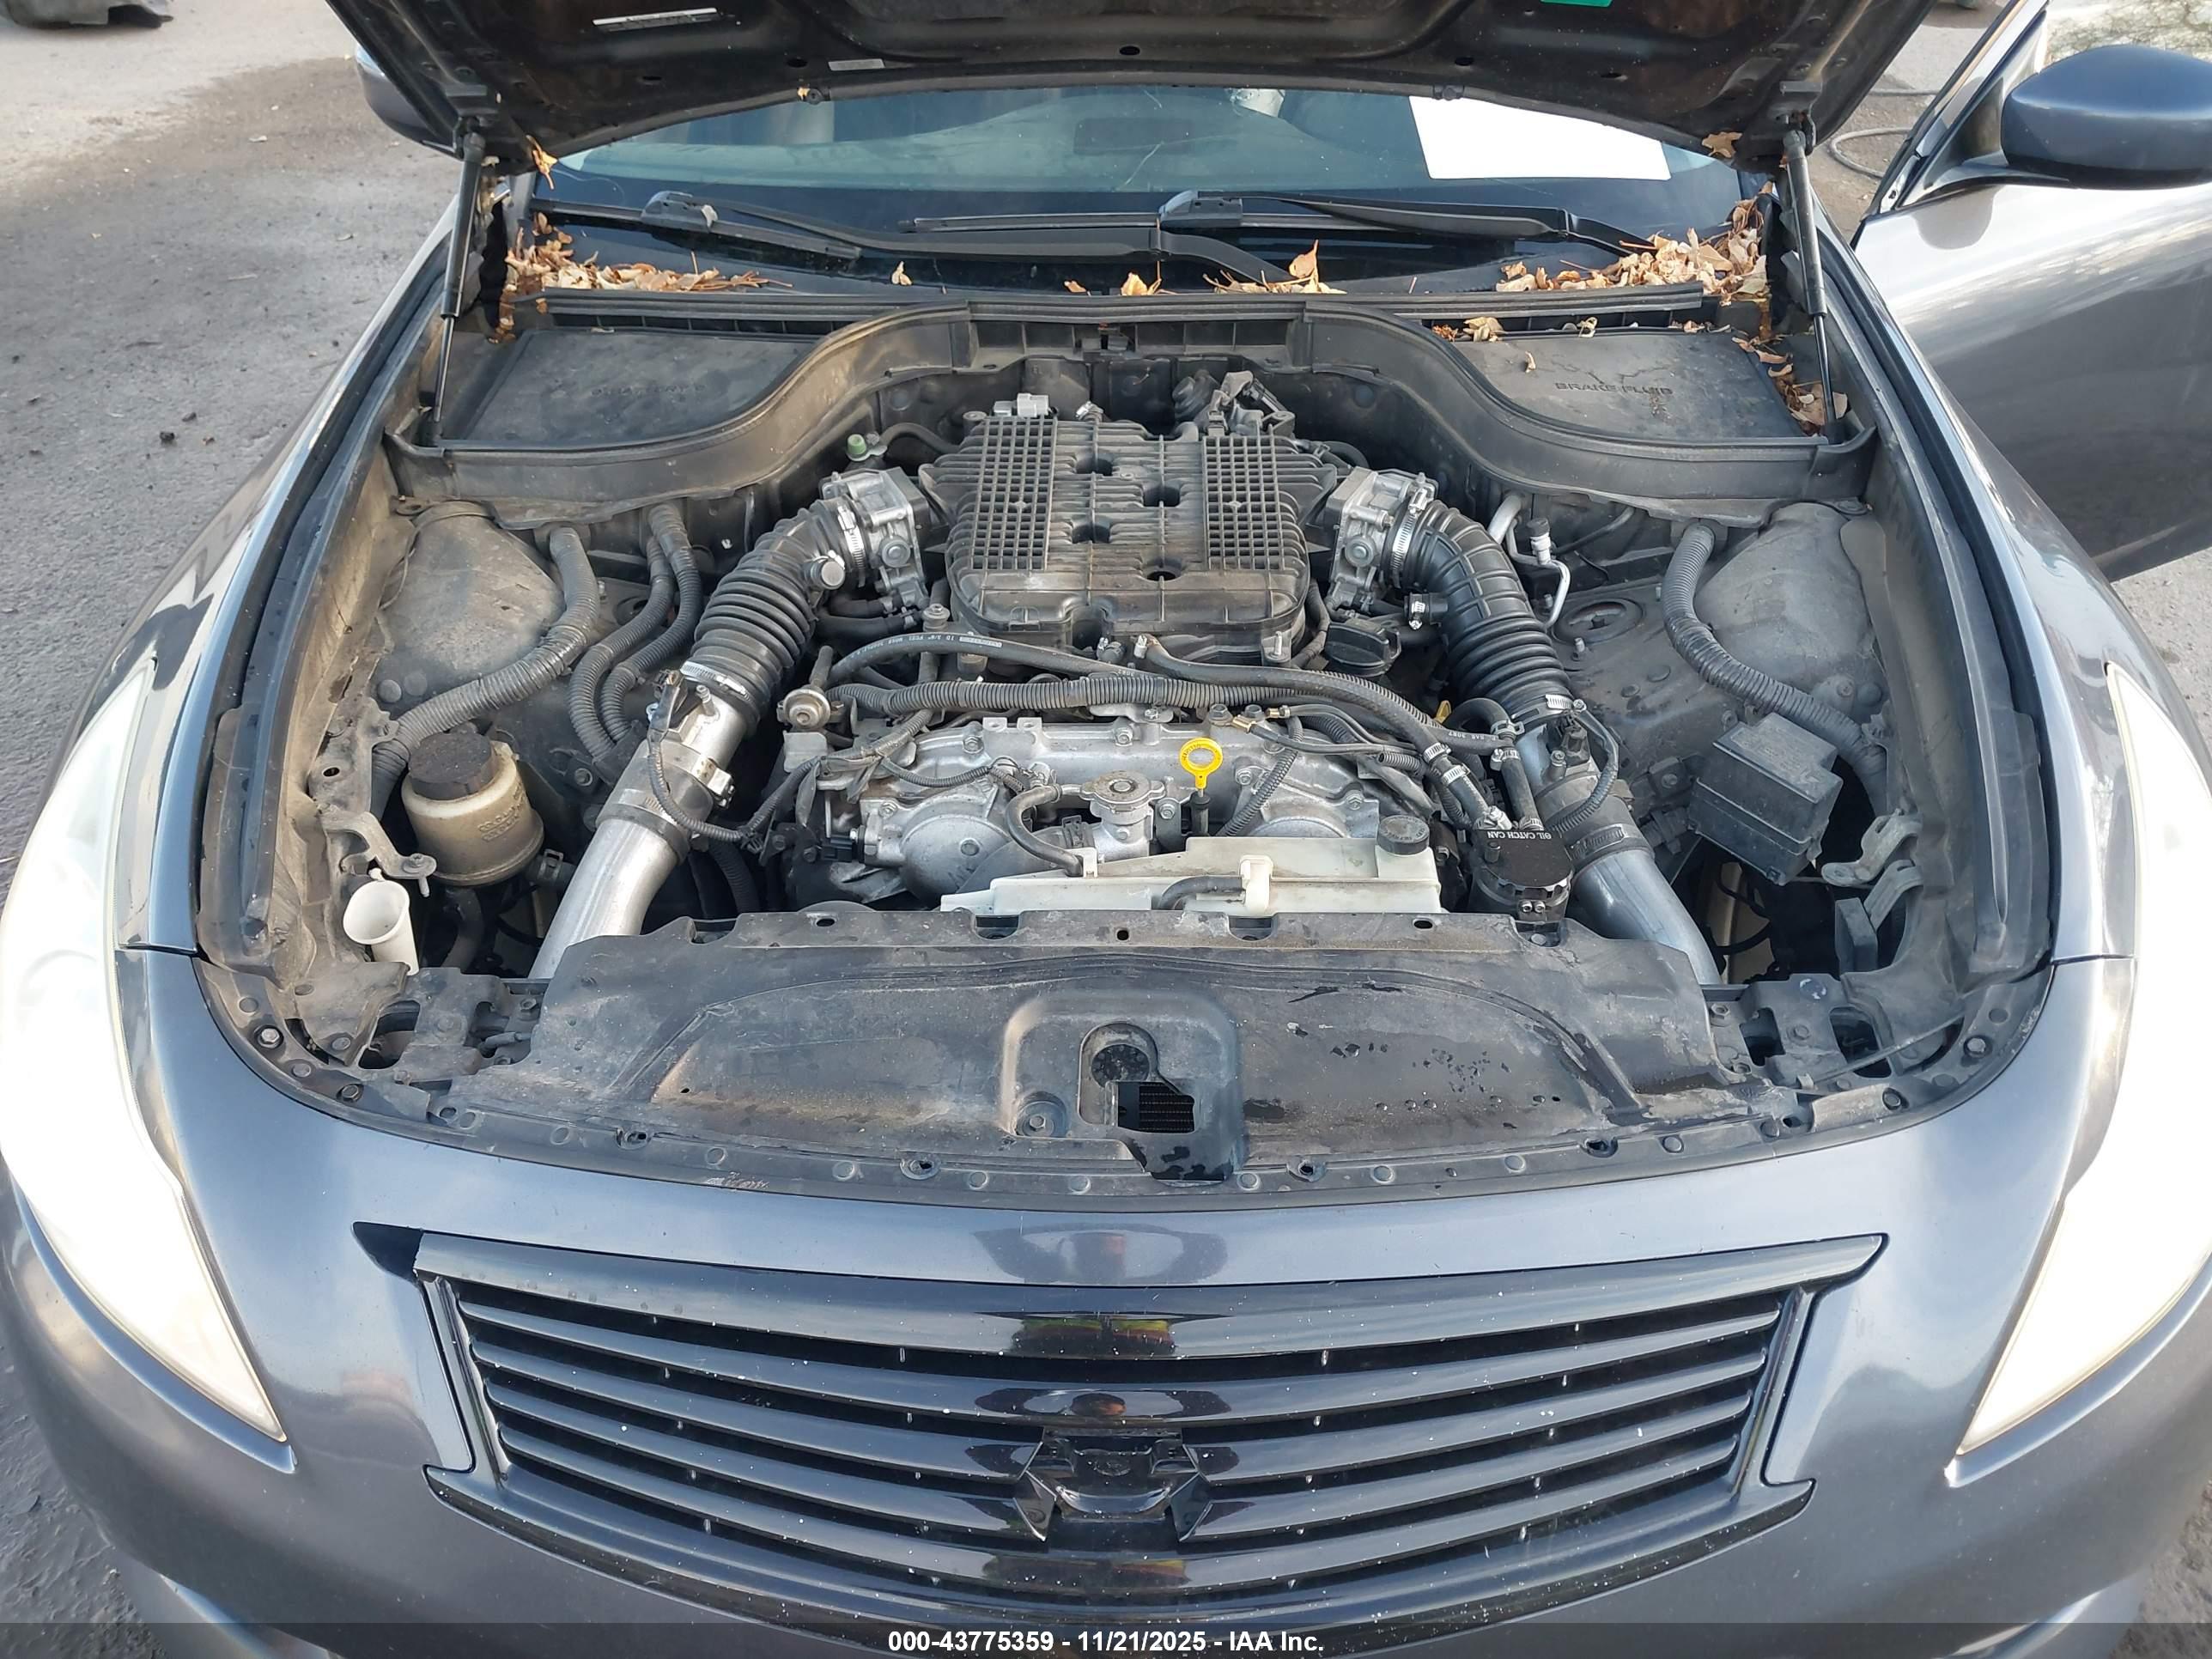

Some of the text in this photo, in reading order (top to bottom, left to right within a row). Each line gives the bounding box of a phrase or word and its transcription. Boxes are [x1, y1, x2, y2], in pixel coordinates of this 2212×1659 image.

[1555, 382, 1673, 395] BRAKE FLUID
[1486, 830, 1505, 839] CAN
[1506, 831, 1535, 840] CATCH
